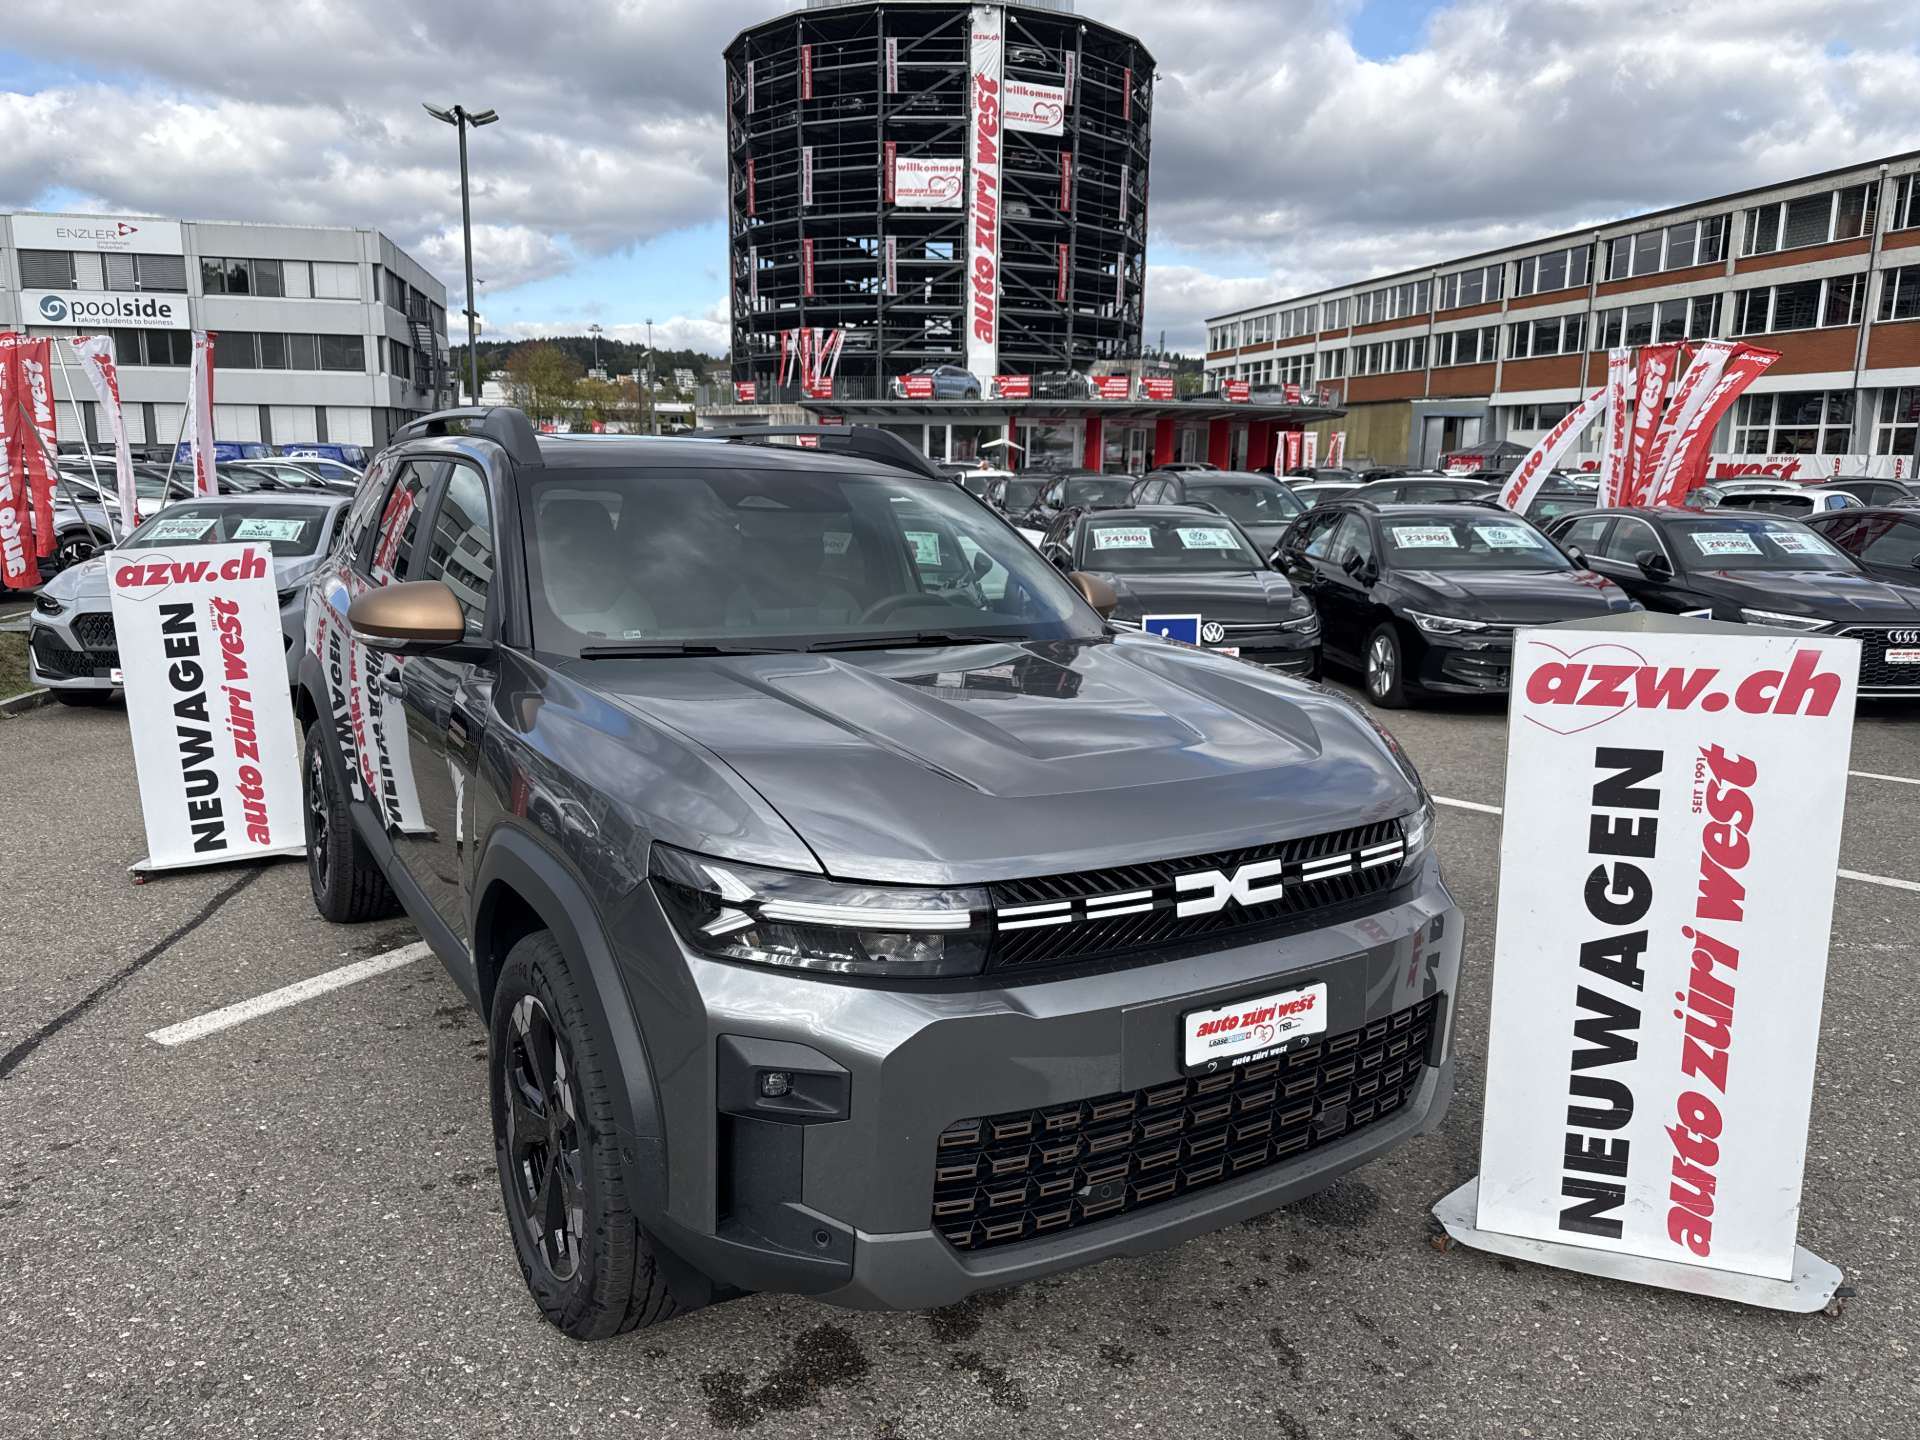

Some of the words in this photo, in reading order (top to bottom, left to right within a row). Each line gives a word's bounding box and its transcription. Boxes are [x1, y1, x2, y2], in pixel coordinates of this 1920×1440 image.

[973, 33, 1000, 41] azw.ch
[975, 72, 999, 164] west
[1005, 86, 1063, 101] willkommen
[897, 162, 962, 173] willkommen
[56, 228, 117, 240] ENZLER
[970, 168, 997, 256] züri
[70, 298, 172, 322] poolside
[78, 317, 100, 325] taking
[102, 317, 133, 325] students
[971, 256, 995, 345] auto
[20, 358, 52, 422] west
[1635, 357, 1667, 429] west
[1506, 450, 1543, 509] auto
[115, 548, 267, 588] azw.ch
[1103, 534, 1147, 543] 24'800
[209, 596, 249, 682] west
[1526, 649, 1841, 718] azw.ch
[159, 602, 228, 853] NEUWAGEN
[221, 685, 261, 763] züri
[1692, 785, 1703, 814] SEIT
[1693, 756, 1706, 781] 1991
[235, 764, 271, 846] auto
[1697, 744, 1758, 922] west
[1196, 1015, 1240, 1038] auto
[1241, 1003, 1277, 1028] züri
[1278, 993, 1316, 1018] west
[1559, 747, 1665, 1240] NEUWAGEN
[1673, 925, 1741, 1095] züri
[1232, 1055, 1251, 1066] auto
[1252, 1049, 1269, 1062] züri
[1270, 1044, 1288, 1056] west
[1664, 1090, 1723, 1258] auto
